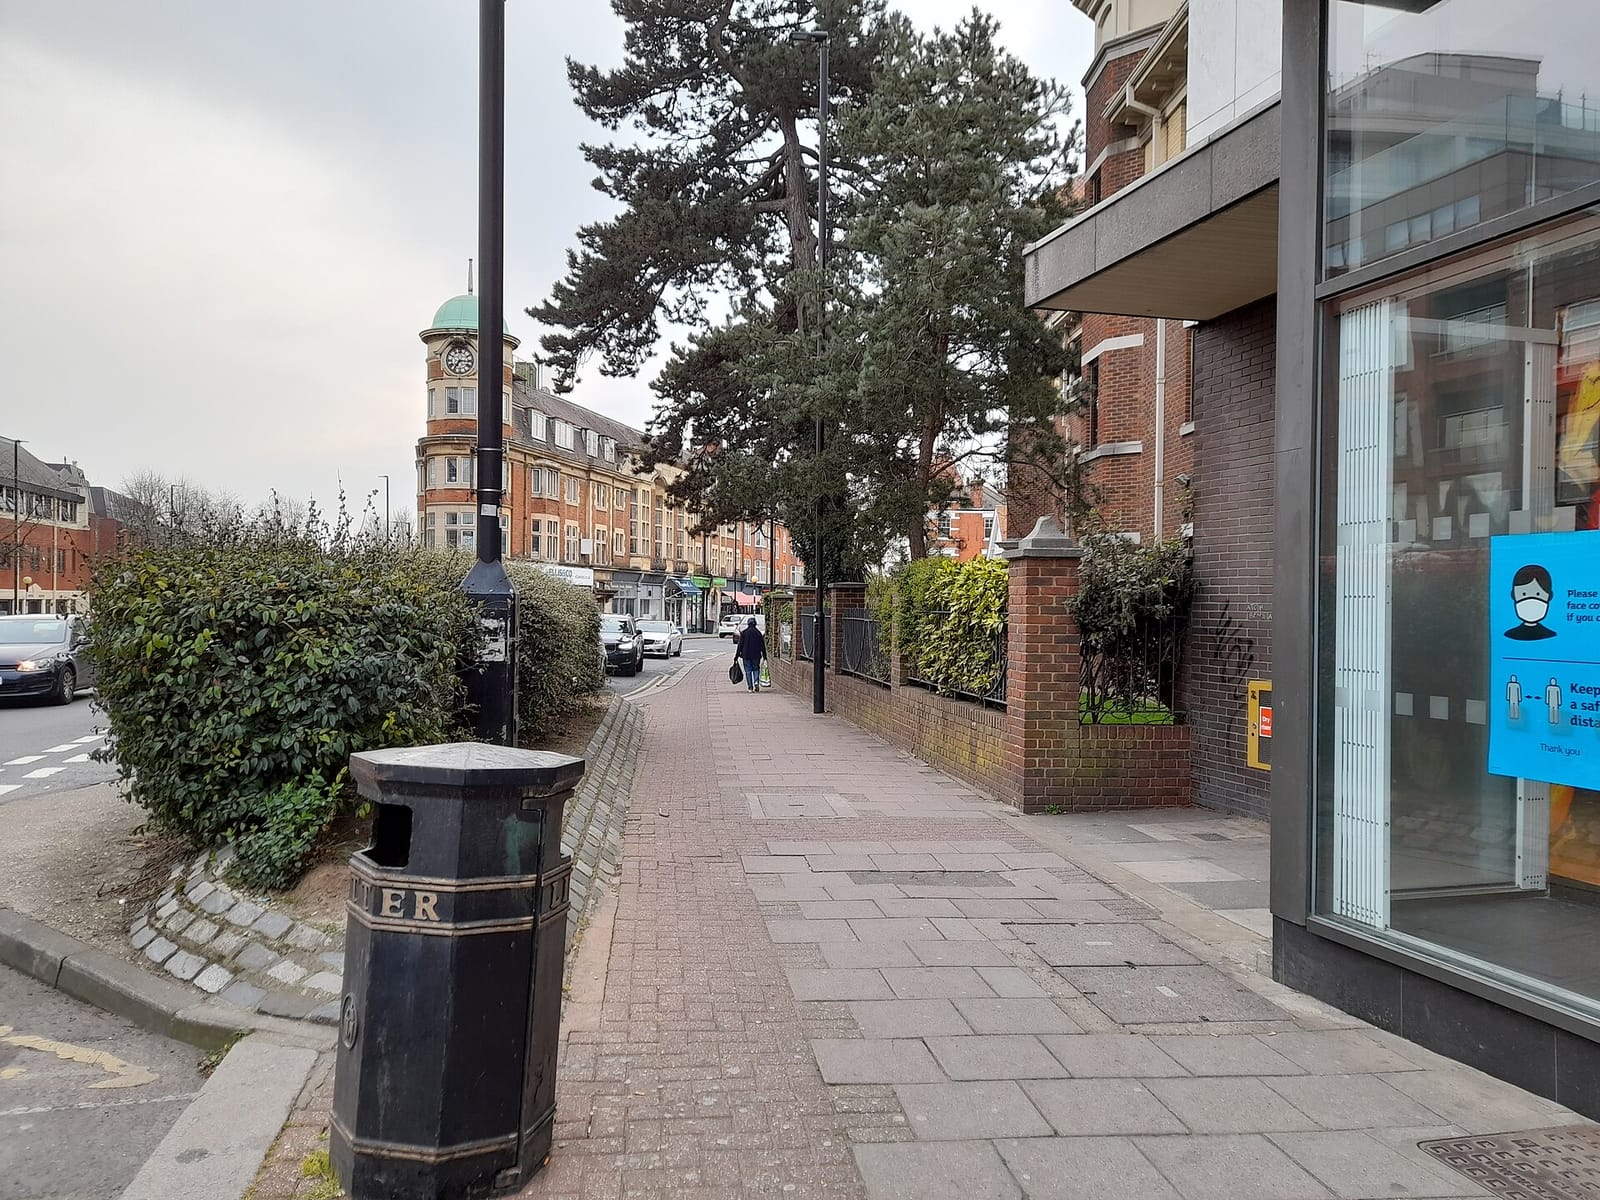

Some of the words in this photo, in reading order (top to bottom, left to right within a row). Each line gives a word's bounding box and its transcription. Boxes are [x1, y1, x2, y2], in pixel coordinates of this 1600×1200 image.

[1567, 589, 1598, 598] Please
[1567, 601, 1586, 610] face
[1588, 602, 1600, 610] co
[1567, 612, 1574, 622] if
[1576, 615, 1593, 624] you
[1570, 683, 1600, 698] Keep
[1570, 701, 1577, 710] a
[1581, 700, 1600, 712] saf
[1540, 743, 1562, 754] Thank
[1565, 747, 1580, 757] you
